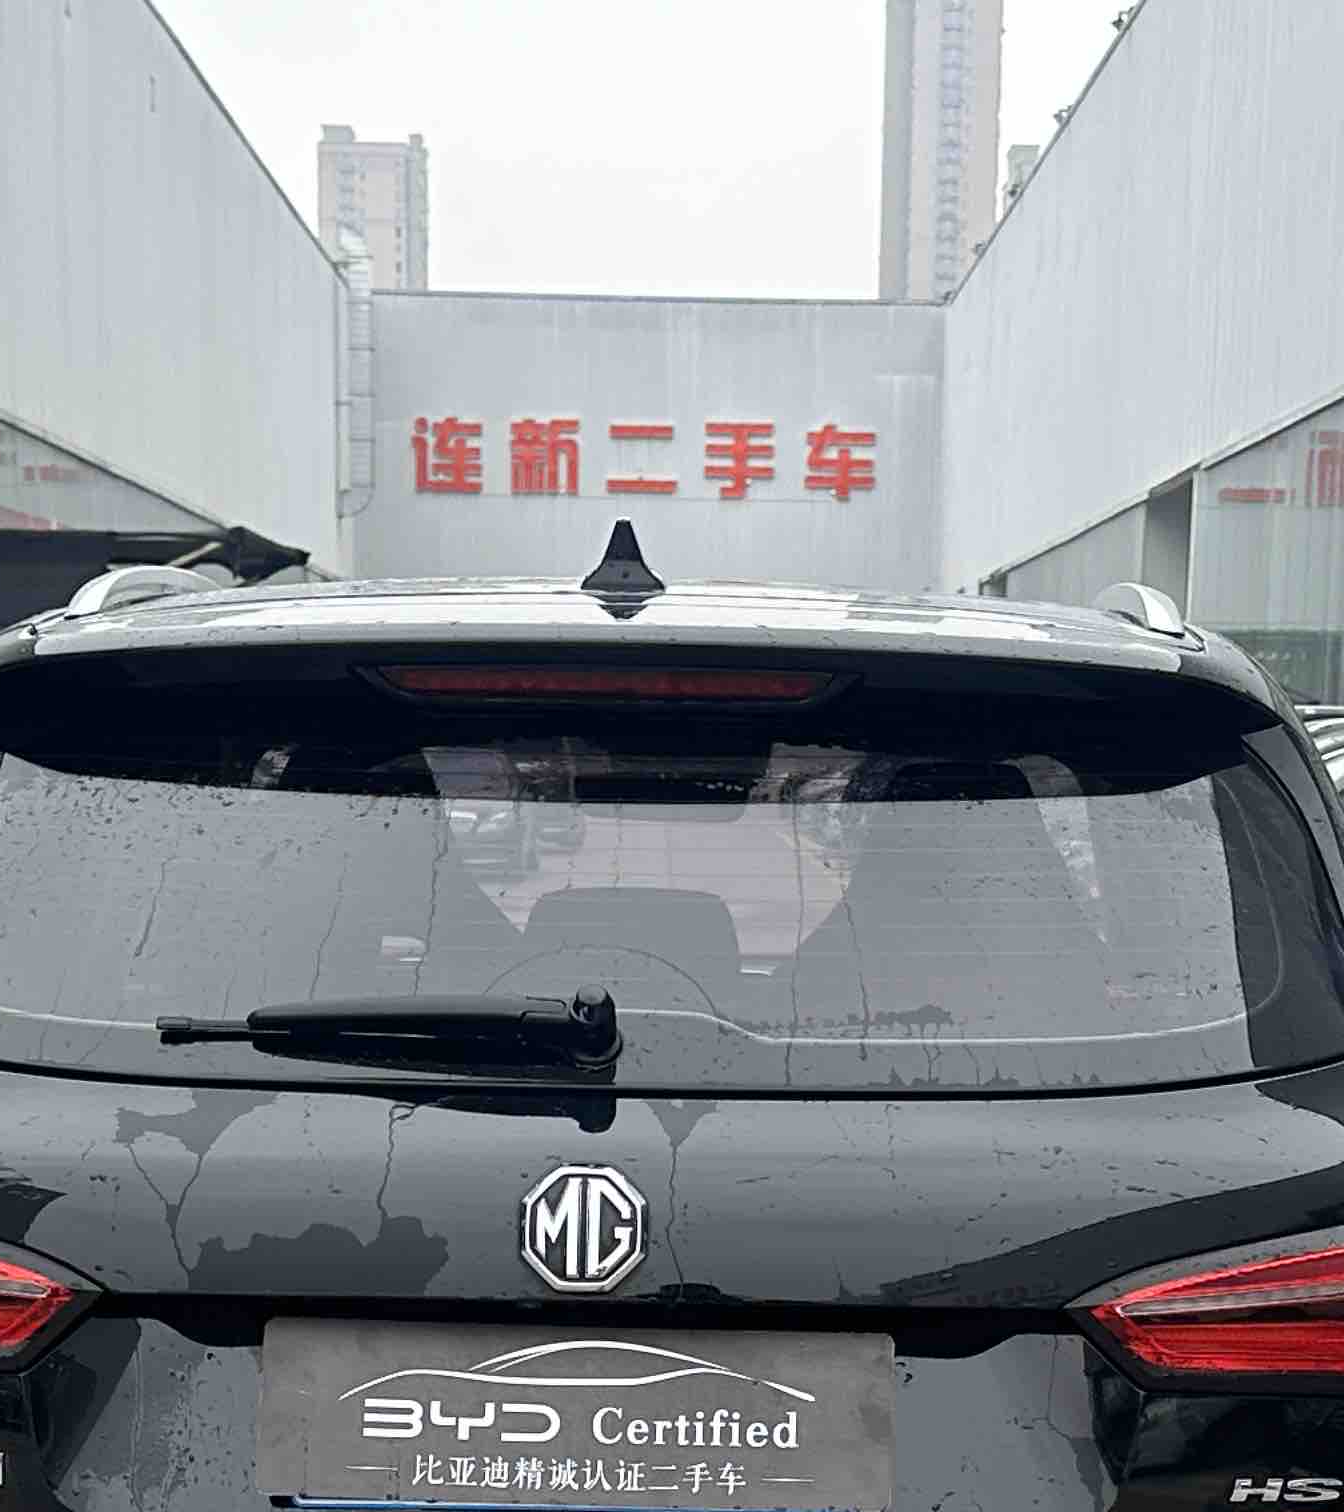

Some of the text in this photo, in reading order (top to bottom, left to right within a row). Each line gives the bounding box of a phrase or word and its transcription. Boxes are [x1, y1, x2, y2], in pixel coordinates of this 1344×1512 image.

[411, 416, 877, 500] 连新二手车
[535, 1176, 634, 1279] MG
[362, 1398, 800, 1449] BYD Certified
[411, 1454, 747, 1495] 比亚迪精诚认证二手车
[1229, 1477, 1344, 1502] HS
